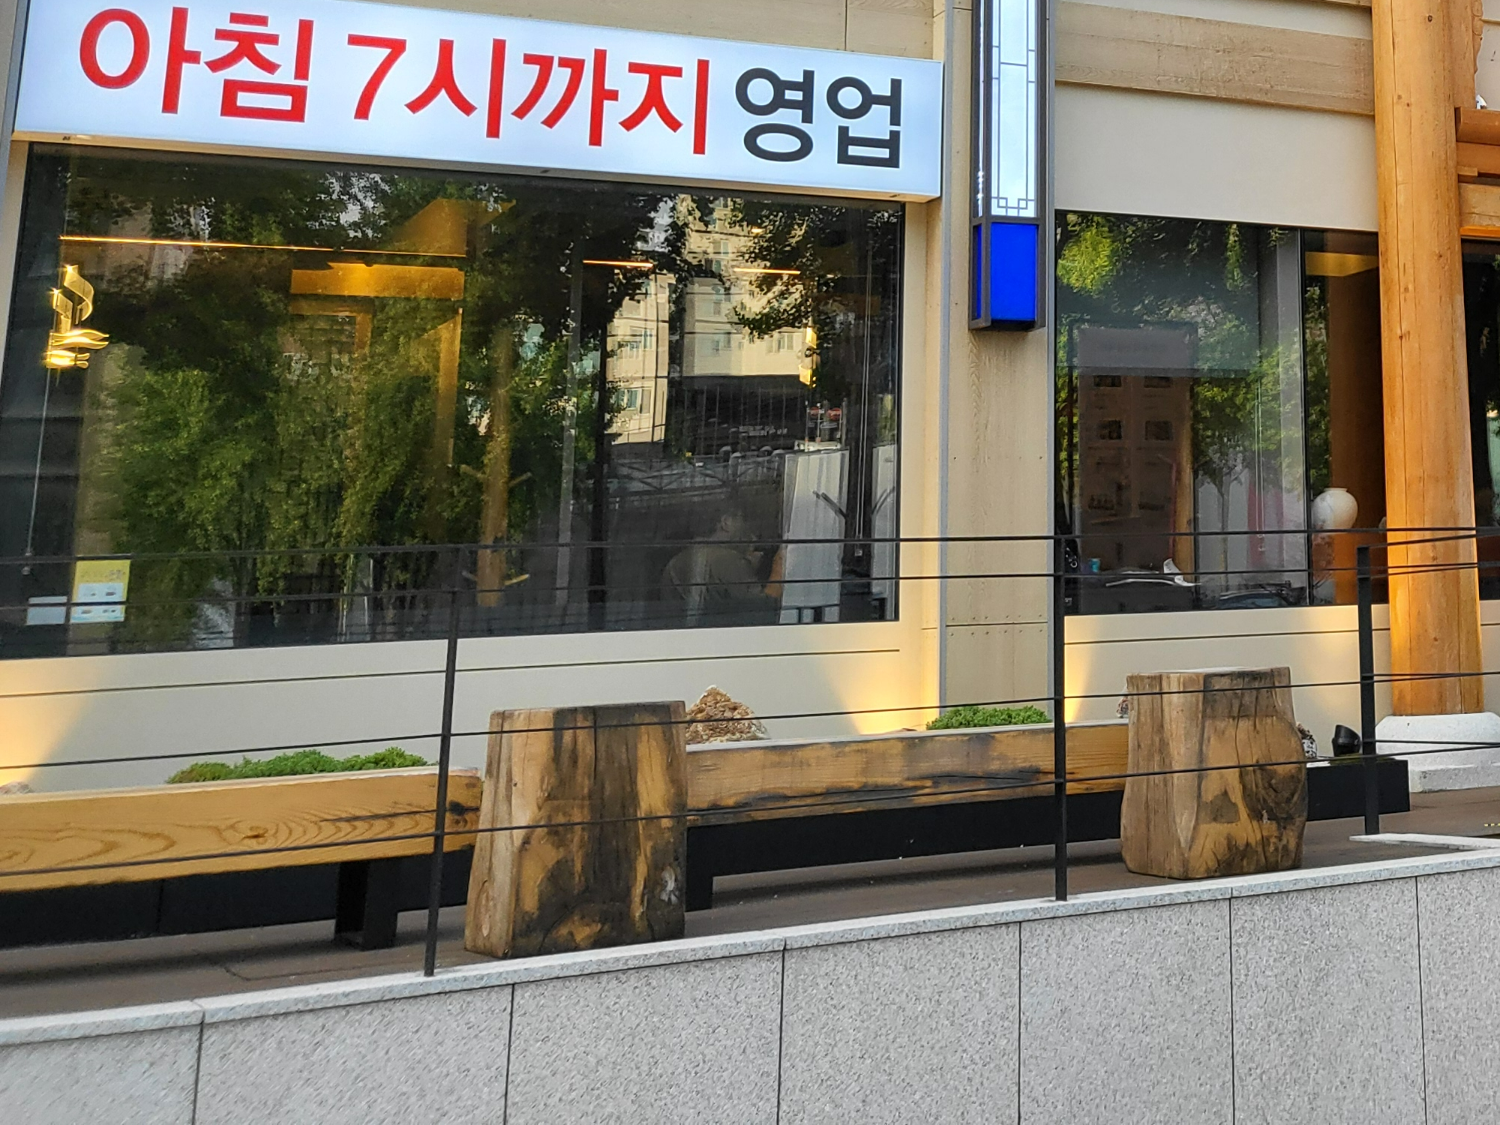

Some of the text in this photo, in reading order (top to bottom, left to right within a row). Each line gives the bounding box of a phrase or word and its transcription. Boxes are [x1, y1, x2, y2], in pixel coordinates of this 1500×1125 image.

[79, 6, 904, 169] 아침 7시까지 영업
